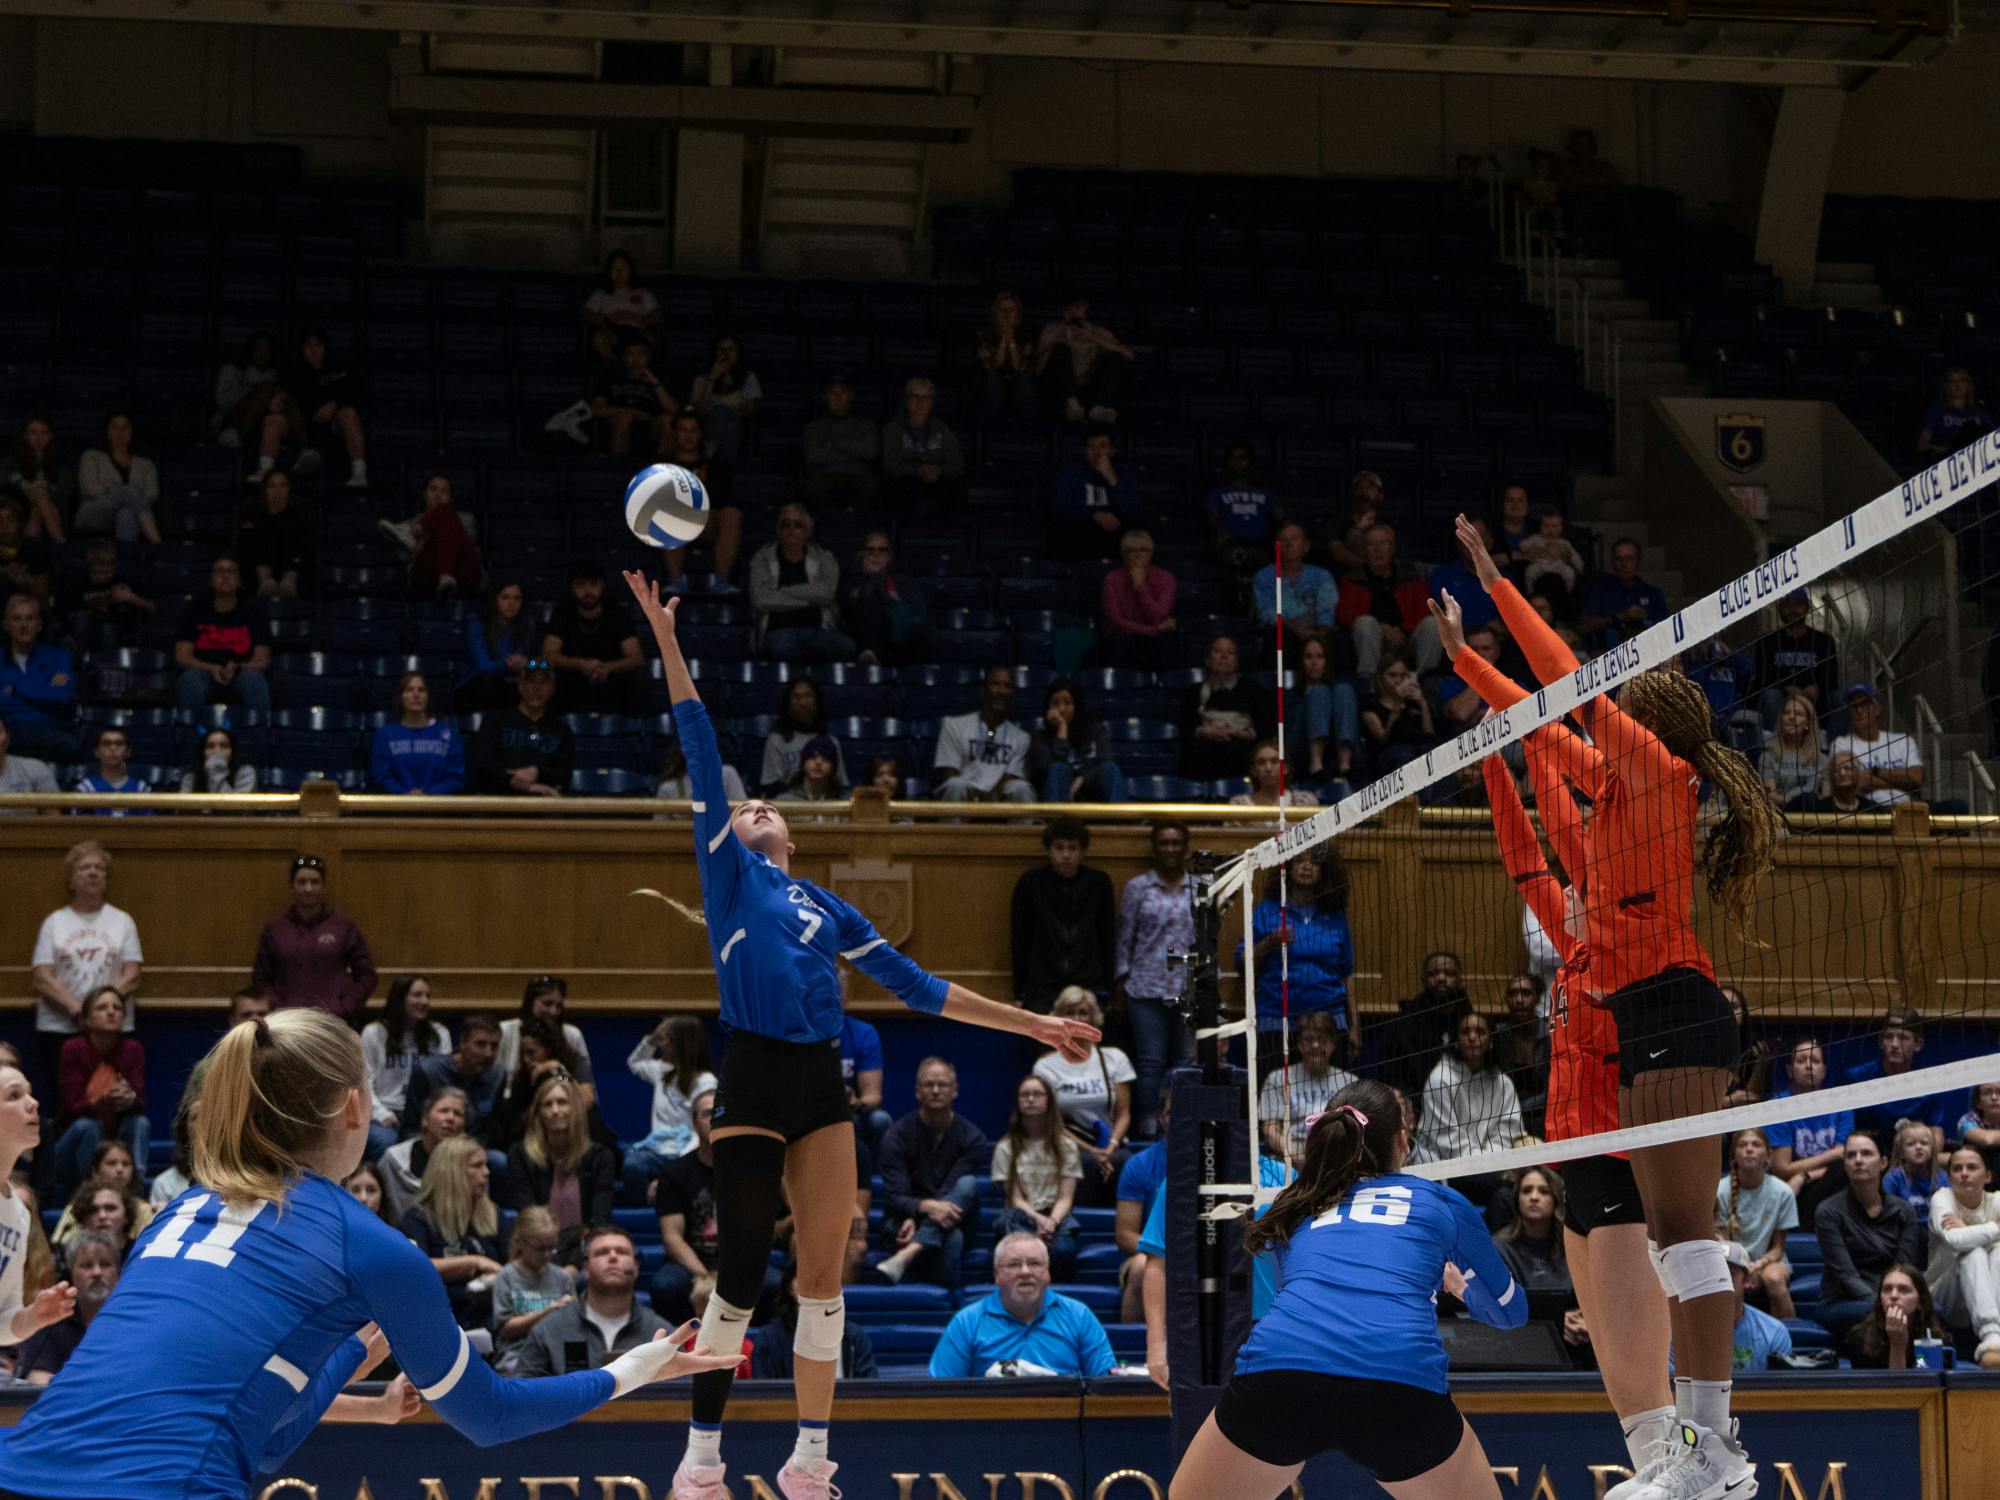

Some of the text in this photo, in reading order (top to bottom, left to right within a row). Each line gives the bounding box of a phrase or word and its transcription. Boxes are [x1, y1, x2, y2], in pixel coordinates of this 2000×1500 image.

[1731, 430, 1754, 461] 6
[1901, 430, 2000, 518] BLUE DEVILS
[1719, 546, 1798, 619] BLUE DEVILS
[1573, 636, 1640, 697] BLUE DEVILS
[1457, 710, 1511, 761] BLUE DEVILS
[1360, 767, 1405, 813] BLUE DEVILS
[798, 908, 822, 945] 7
[1203, 1137, 1217, 1185] sports
[140, 1193, 269, 1269] 11
[1309, 1185, 1414, 1230] 16
